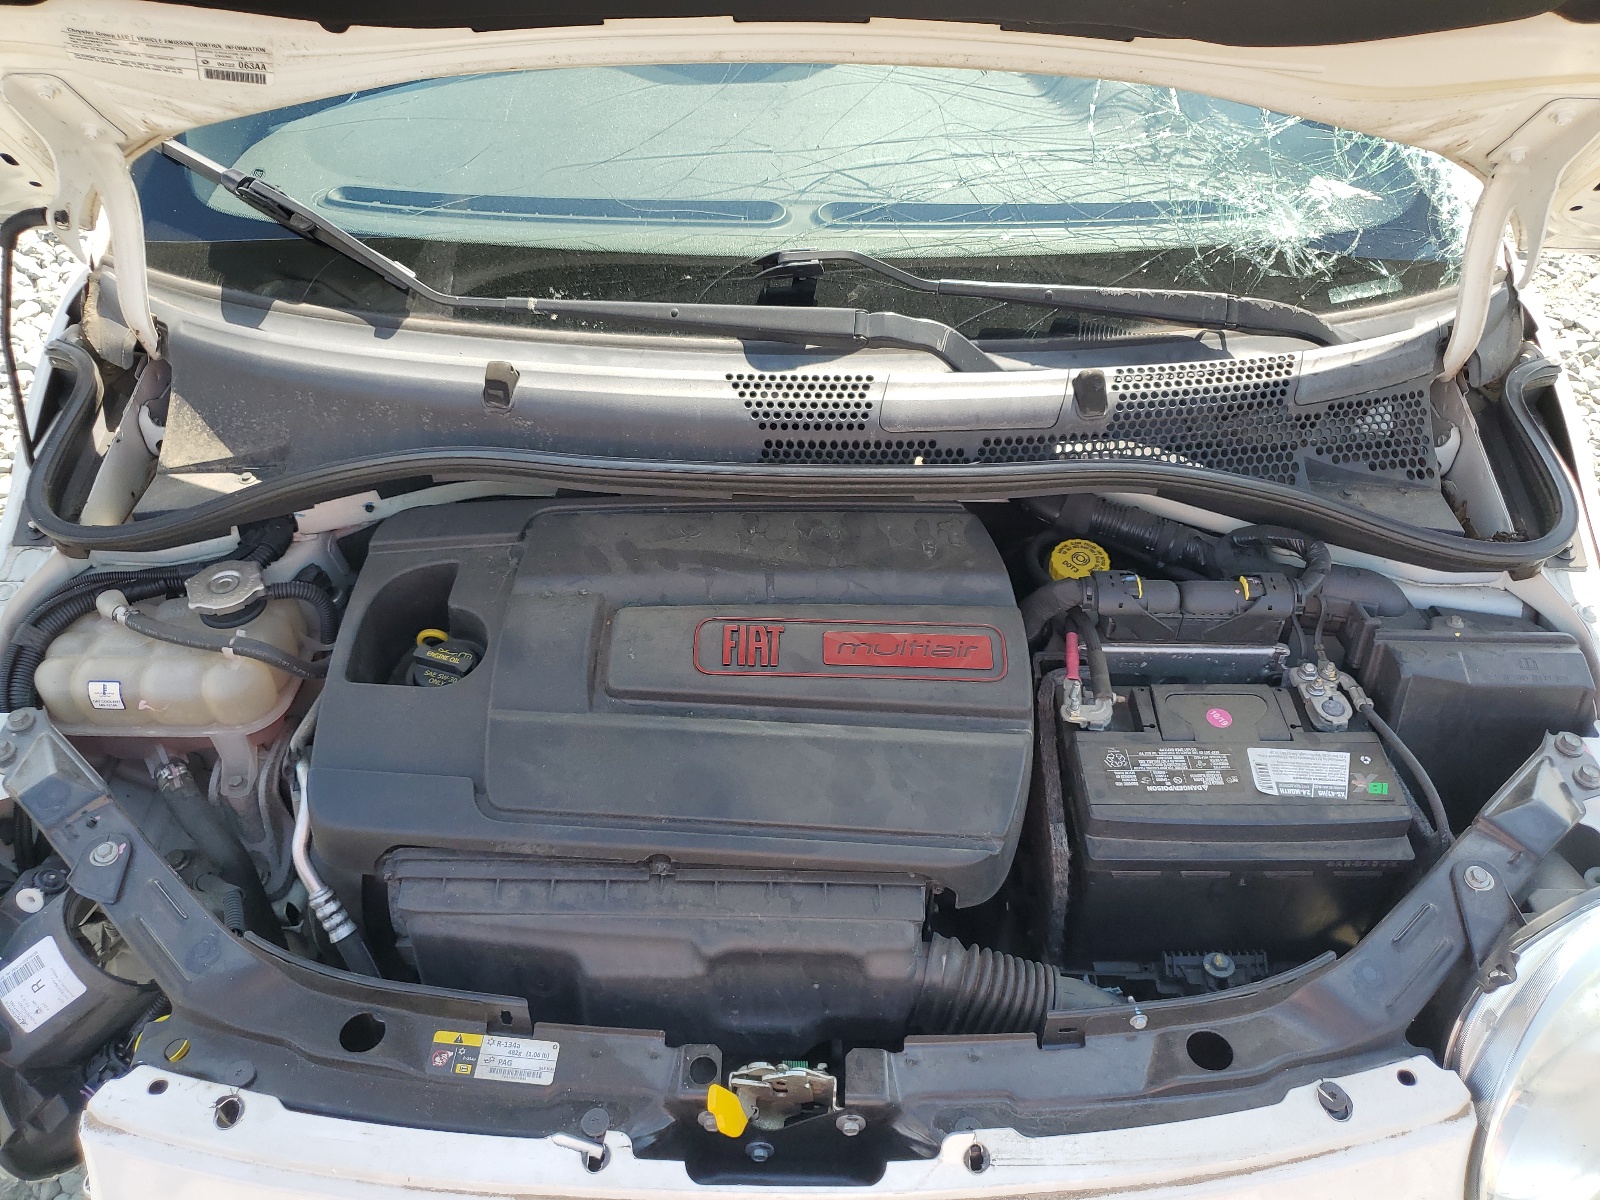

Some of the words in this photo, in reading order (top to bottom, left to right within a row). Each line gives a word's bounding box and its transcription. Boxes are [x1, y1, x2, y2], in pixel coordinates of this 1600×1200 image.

[225, 44, 266, 52] INFORMATION
[1062, 560, 1079, 573] DOT3
[721, 624, 785, 667] FIAT
[836, 639, 979, 658] multiair
[426, 650, 449, 660] ENGINE
[424, 669, 436, 677] SAE
[428, 677, 446, 686] ONLY
[1210, 710, 1229, 726] 10/19
[31, 979, 46, 993] R
[496, 1041, 521, 1049] R-134a
[507, 1049, 522, 1057] 482g
[498, 1059, 513, 1067] PAG
